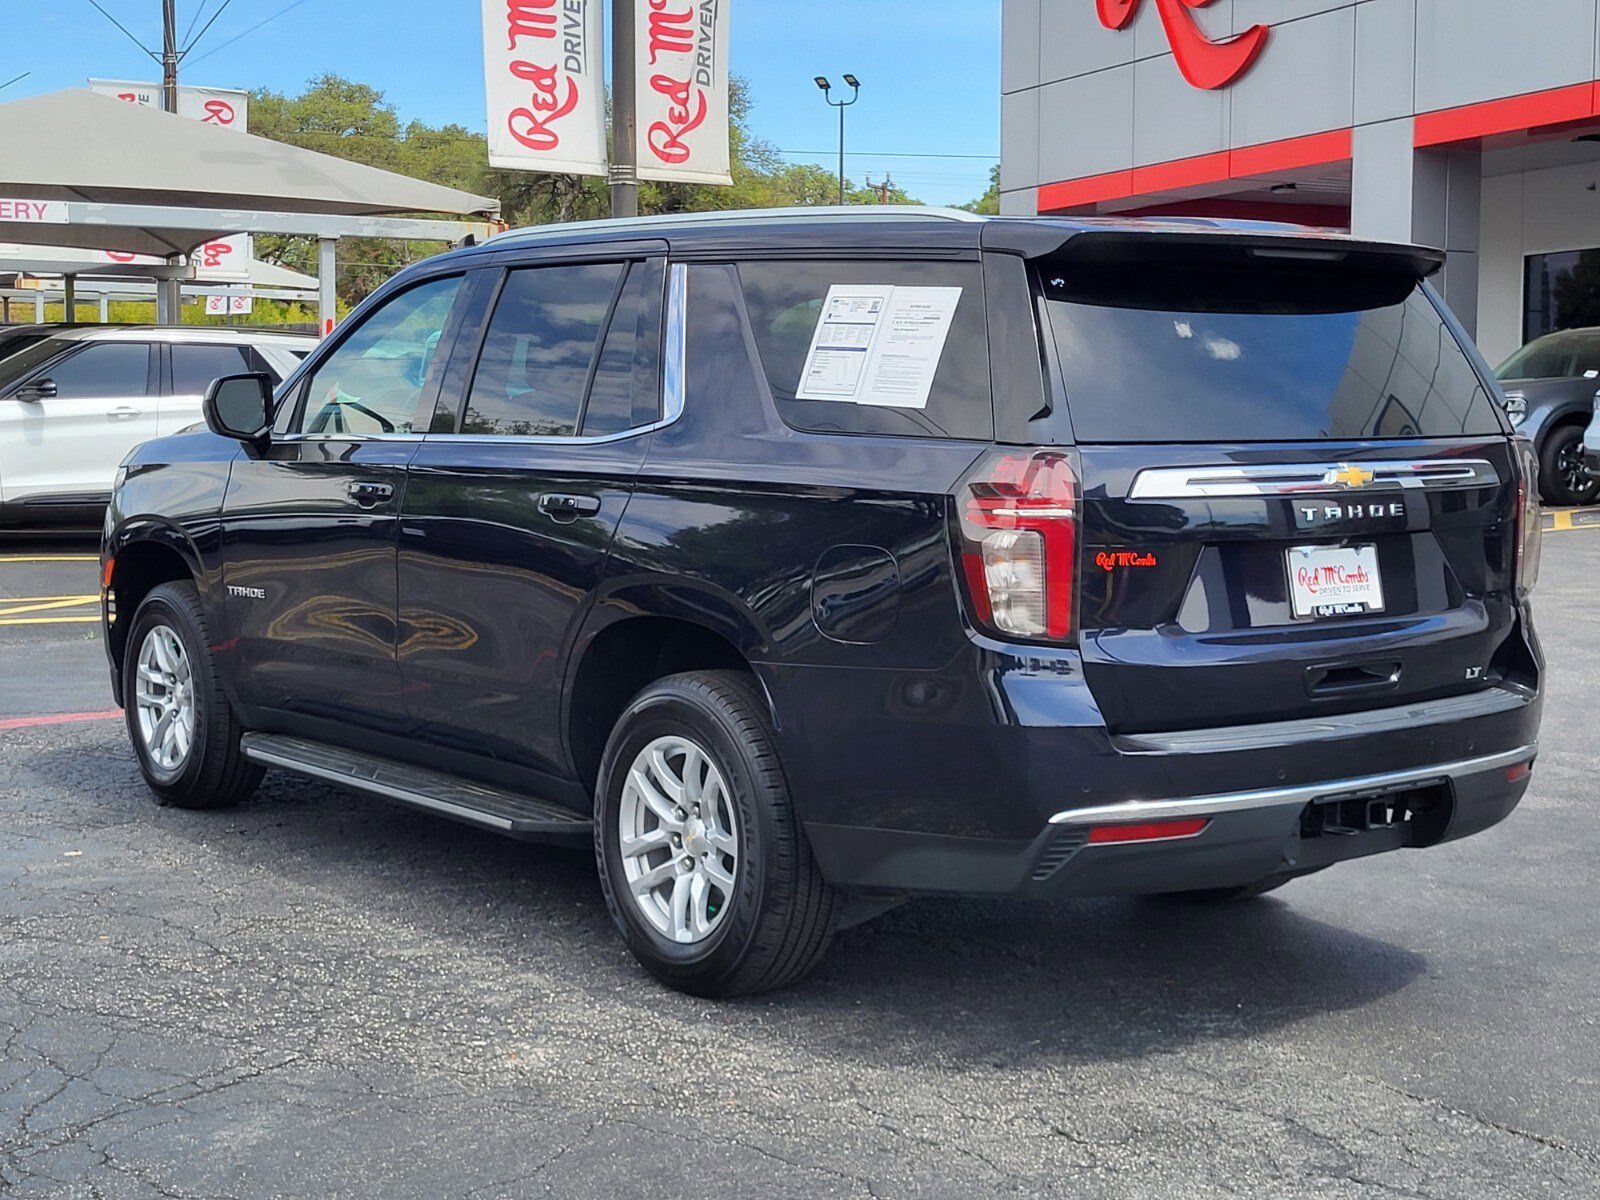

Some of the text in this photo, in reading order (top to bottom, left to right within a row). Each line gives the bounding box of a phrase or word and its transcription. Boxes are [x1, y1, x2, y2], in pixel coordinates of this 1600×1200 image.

[508, 60, 579, 150] Red
[647, 74, 708, 164] Red
[1301, 504, 1404, 521] TAHOE
[1096, 552, 1157, 571] Red McCombs
[1298, 565, 1369, 593] Red McCombs
[227, 585, 265, 599] TAHOE
[1320, 583, 1371, 595] DRIVEN TO SERVE
[1465, 666, 1482, 679] LT
